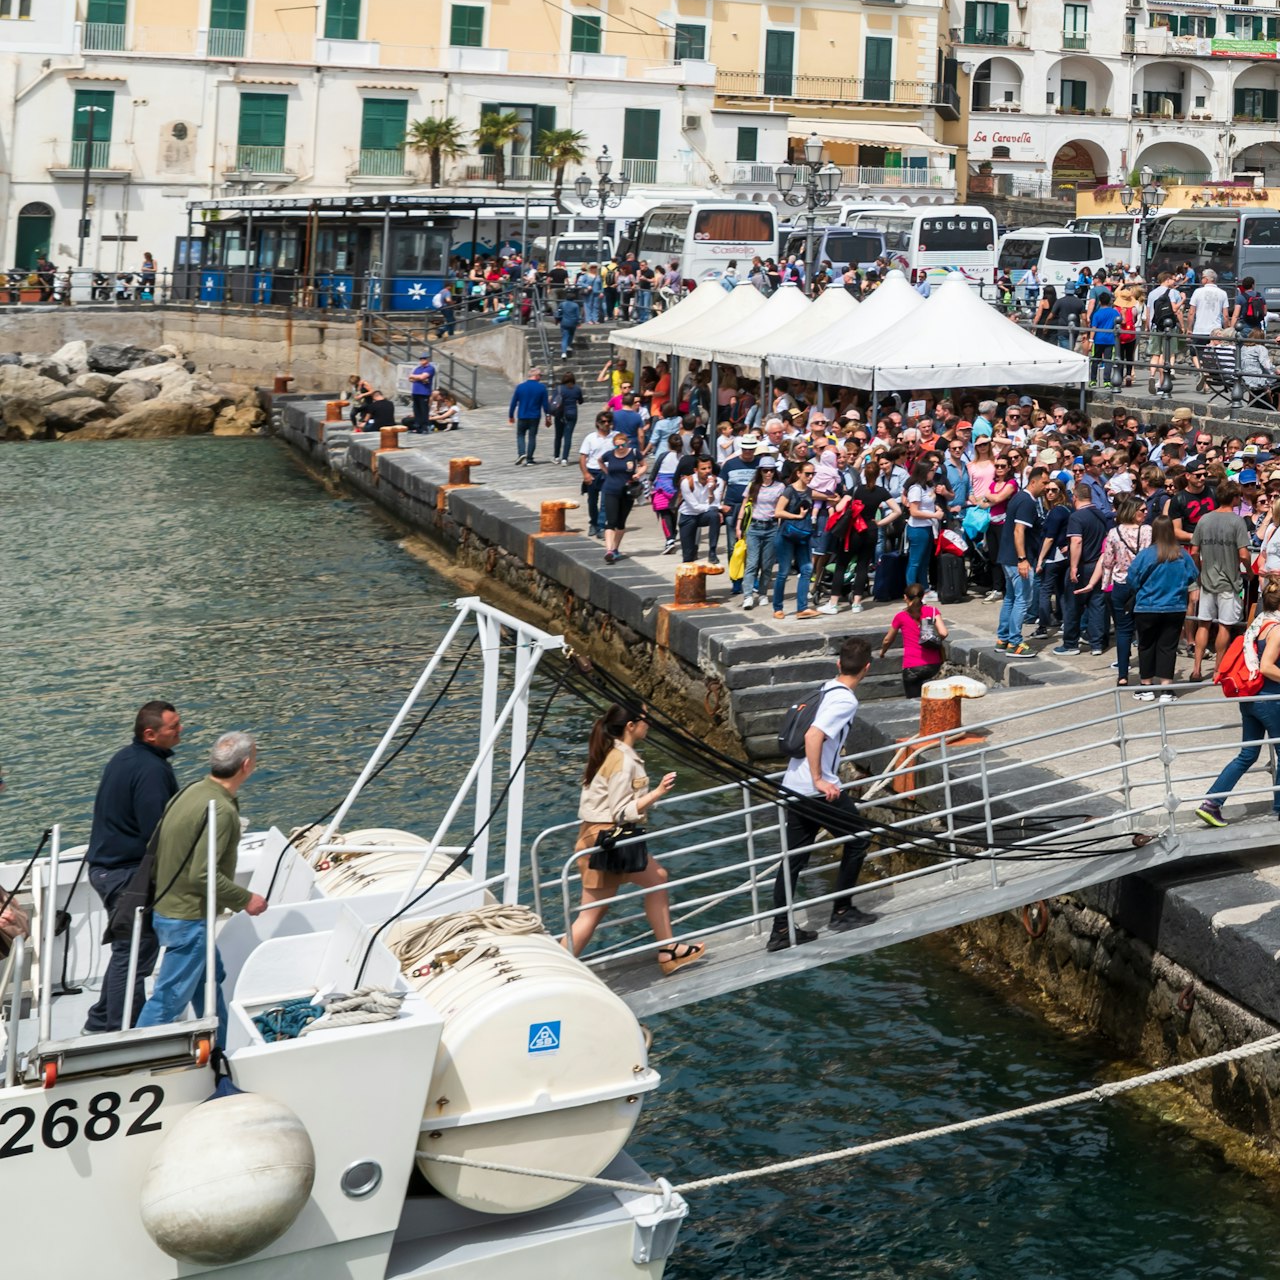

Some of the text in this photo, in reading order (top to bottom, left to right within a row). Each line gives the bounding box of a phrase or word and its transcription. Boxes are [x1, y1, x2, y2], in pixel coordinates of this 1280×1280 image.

[973, 131, 1032, 144] La Caravella
[0, 1084, 165, 1159] 2682
